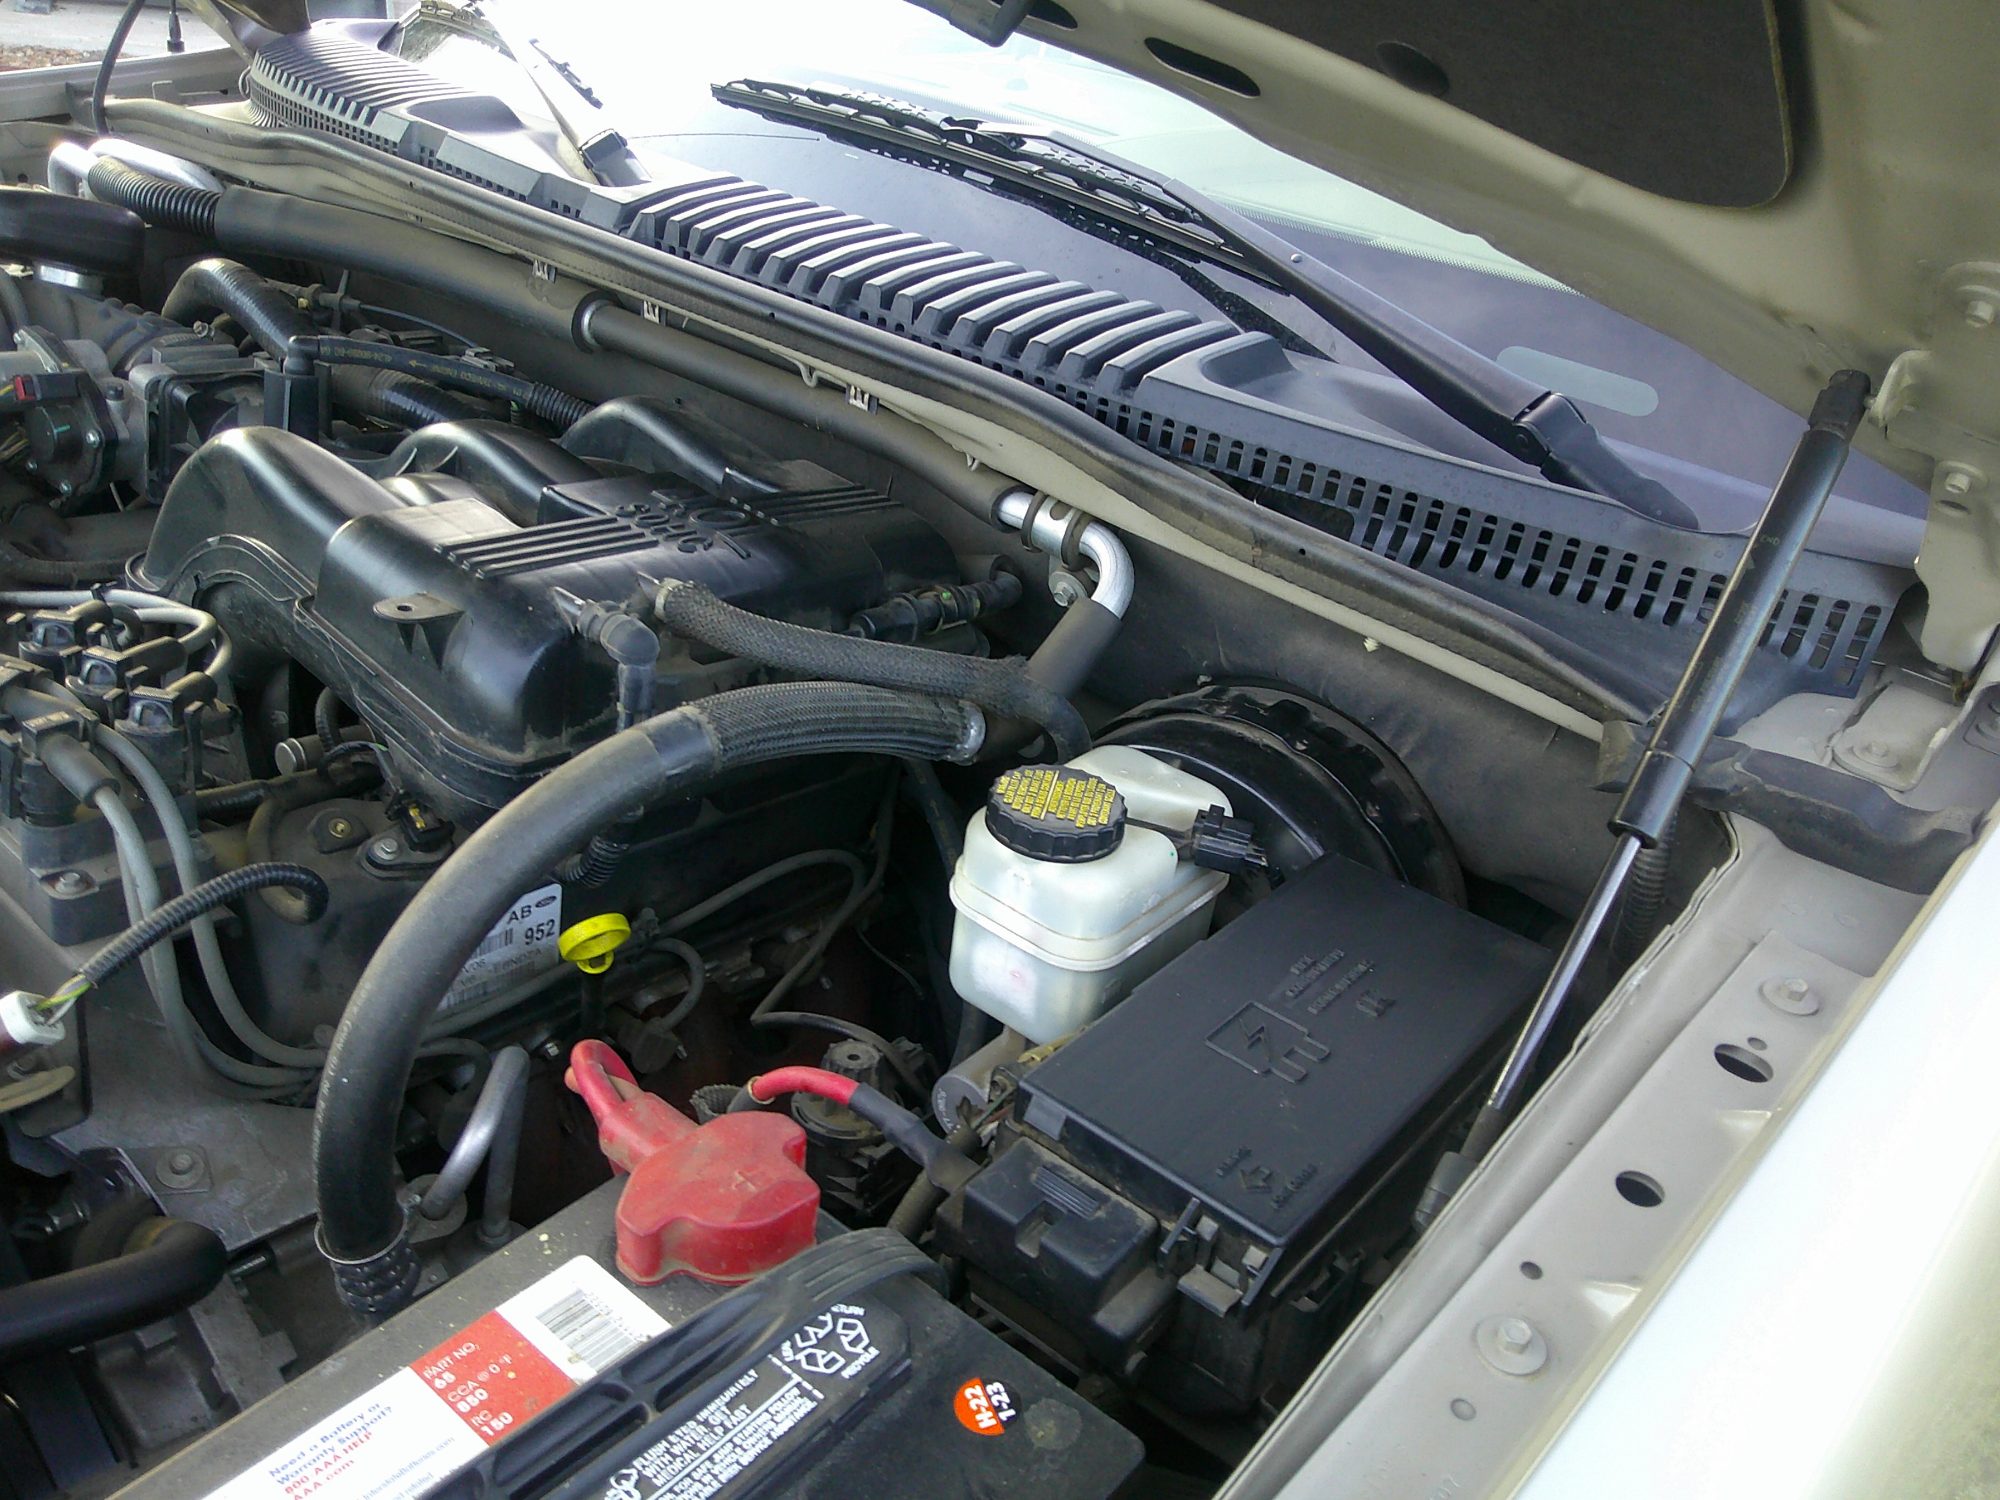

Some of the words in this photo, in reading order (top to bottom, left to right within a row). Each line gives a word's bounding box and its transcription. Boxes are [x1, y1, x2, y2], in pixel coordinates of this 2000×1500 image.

[525, 919, 556, 946] 952
[423, 1355, 454, 1380] PART
[447, 1380, 480, 1402] CCA
[964, 1385, 998, 1429] H-22
[985, 1382, 1017, 1421] 1-23
[269, 1451, 305, 1476] Need
[321, 1412, 364, 1442] Battery
[313, 1453, 341, 1473] AAA
[343, 1431, 373, 1453] HELP
[653, 1448, 700, 1485] MEDICAL
[697, 1425, 725, 1449] HELP
[725, 1405, 751, 1426] FAST
[277, 1445, 335, 1484] Warranty
[643, 1453, 673, 1477] WITH
